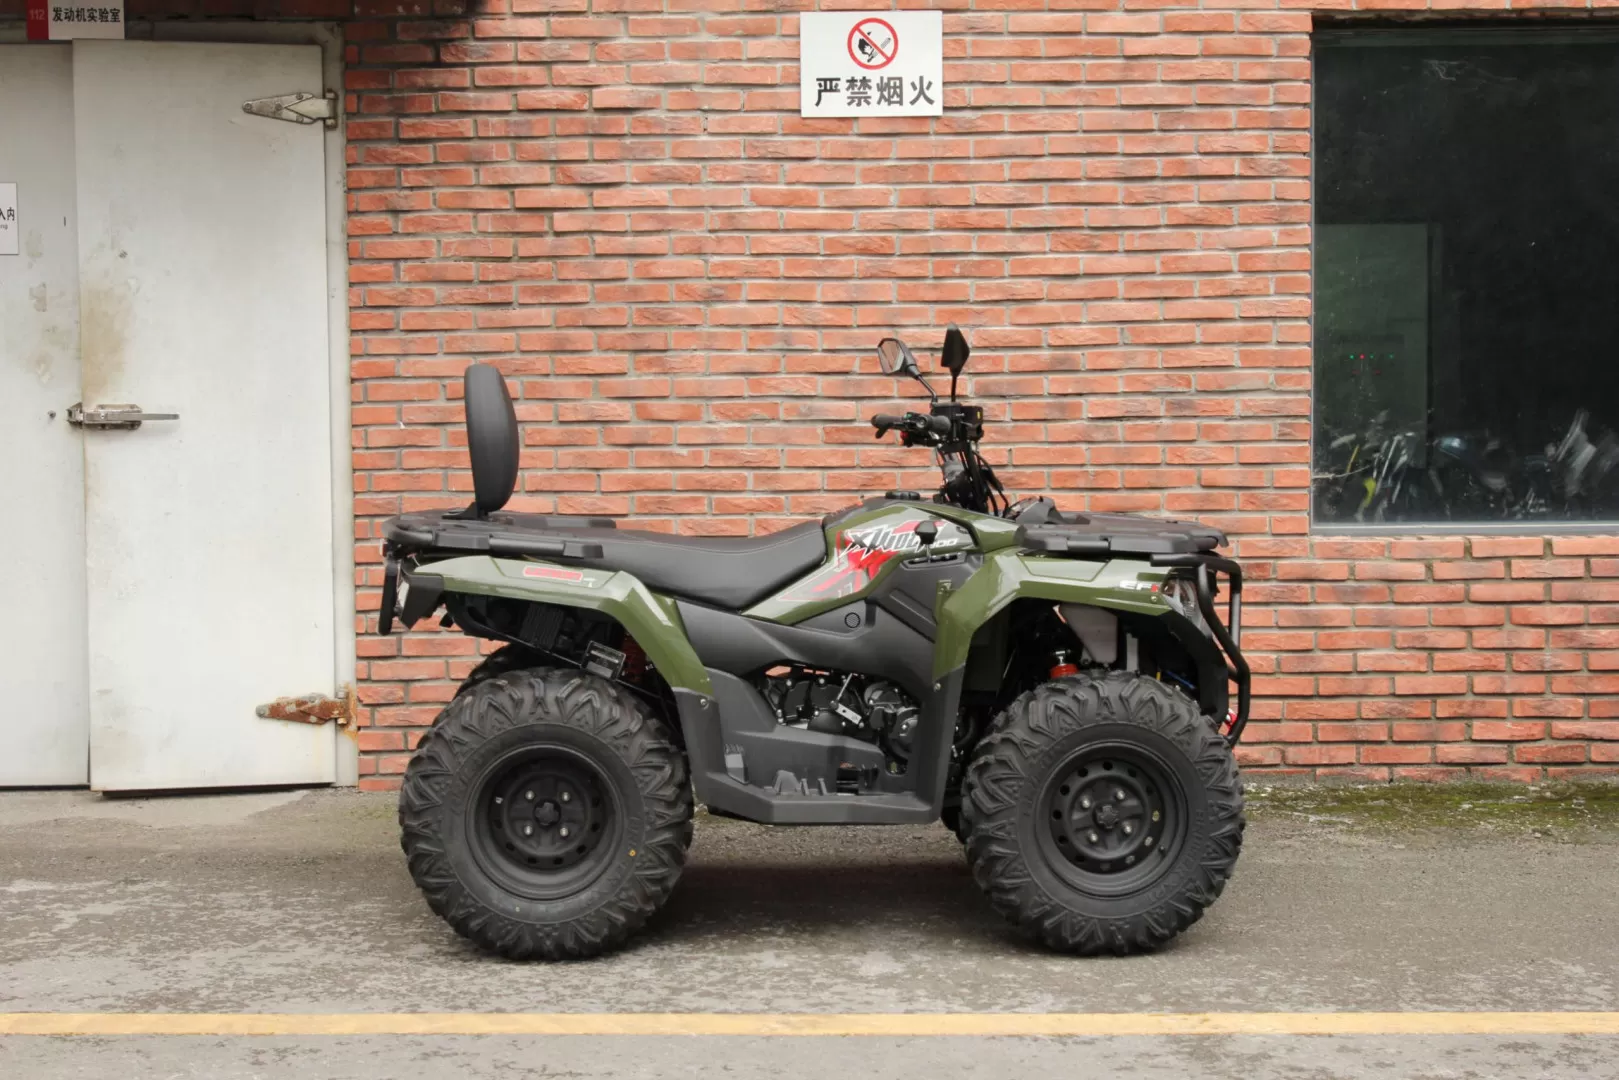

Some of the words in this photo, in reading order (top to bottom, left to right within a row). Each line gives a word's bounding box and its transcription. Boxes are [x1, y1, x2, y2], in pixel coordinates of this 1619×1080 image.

[30, 8, 45, 20] 112
[52, 7, 121, 22] 发动机实验室
[815, 75, 935, 108] 严禁烟火
